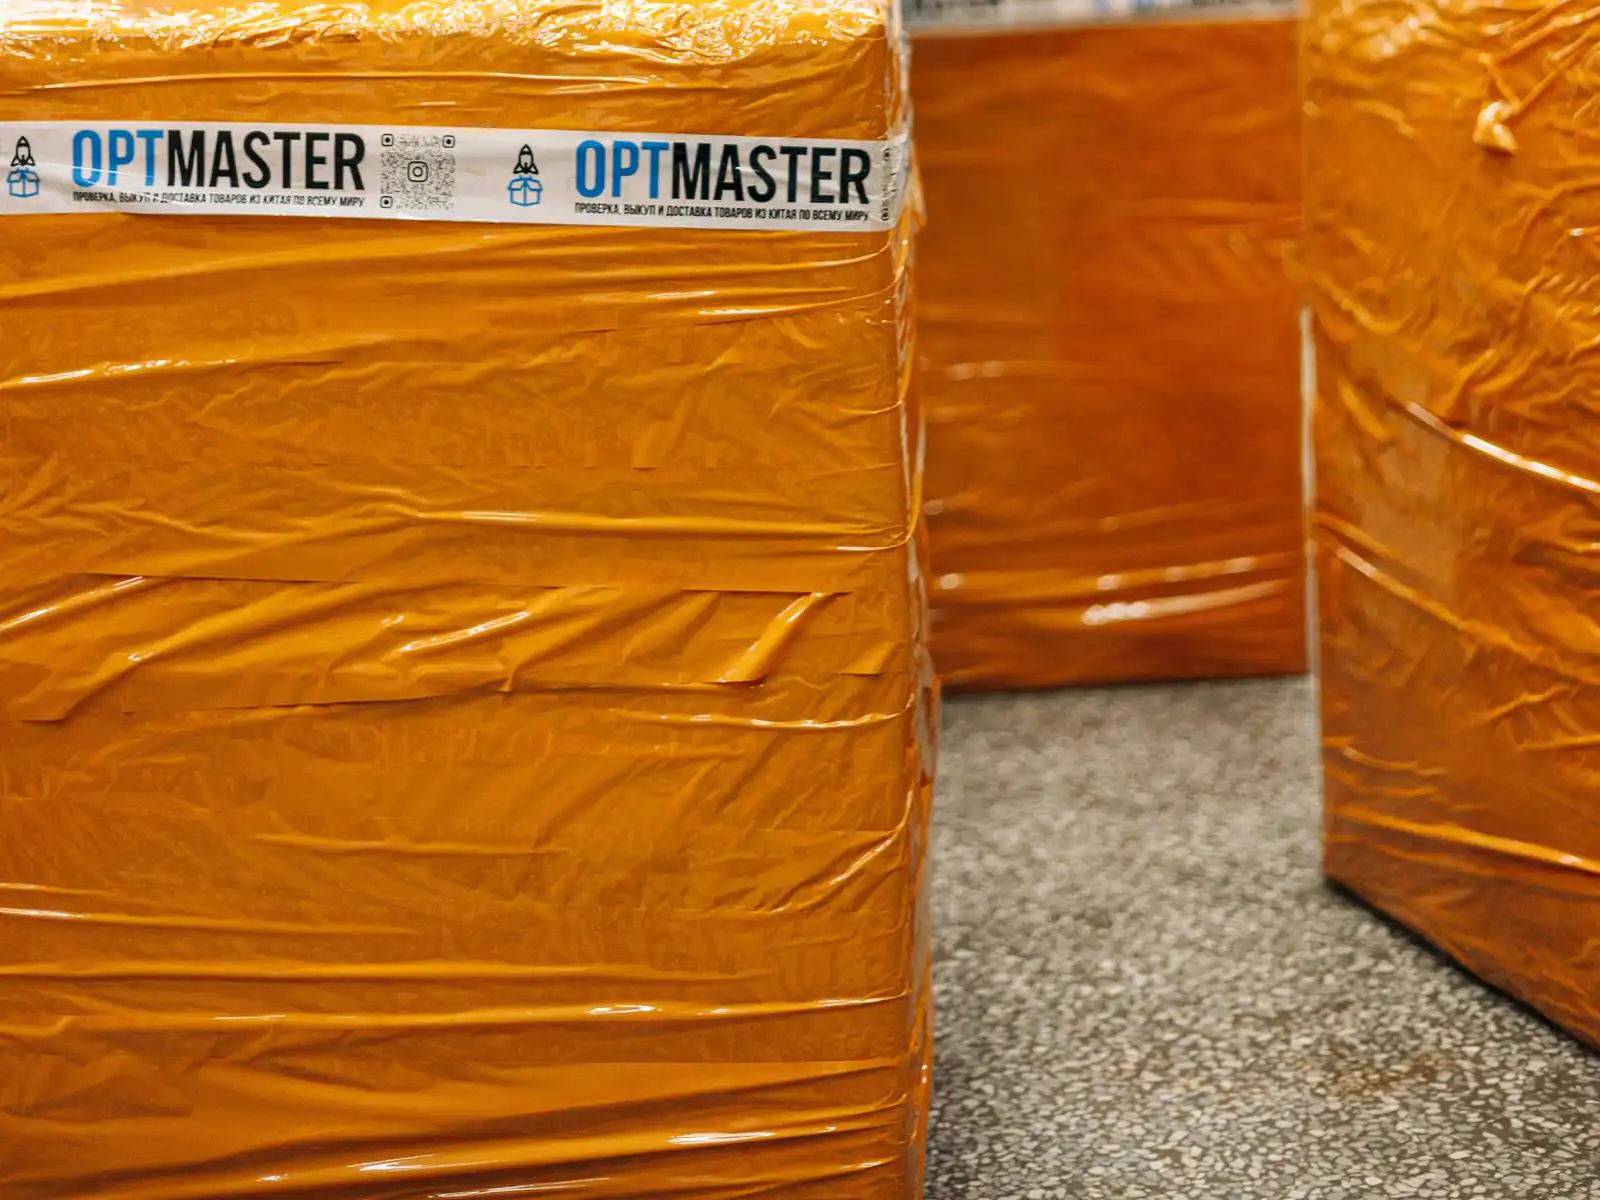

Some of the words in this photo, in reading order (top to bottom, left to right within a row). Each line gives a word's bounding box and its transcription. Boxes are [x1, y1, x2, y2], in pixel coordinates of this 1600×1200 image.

[71, 129, 366, 191] OPTMASTER
[574, 140, 871, 204] OPTMASTER
[209, 193, 247, 204] ТОВАРОВ
[250, 194, 261, 204] ИЗ
[263, 194, 291, 205] КИТАЯ
[294, 195, 305, 205] ПО
[307, 196, 338, 207] ВСЕМУ
[340, 196, 365, 207] МИРУ
[574, 202, 621, 215] ПРОВЕРКА,
[623, 204, 656, 215] ВЫКУП
[658, 204, 665, 215] И
[666, 205, 712, 217] ДОСТАВКА
[715, 206, 752, 219] ТОВАРОВ
[755, 208, 766, 219] ИЗ
[769, 208, 796, 220] КИТАЯ
[800, 209, 810, 220] ПО
[813, 210, 842, 221] ВСЕМУ
[844, 211, 869, 222] МИРУ
